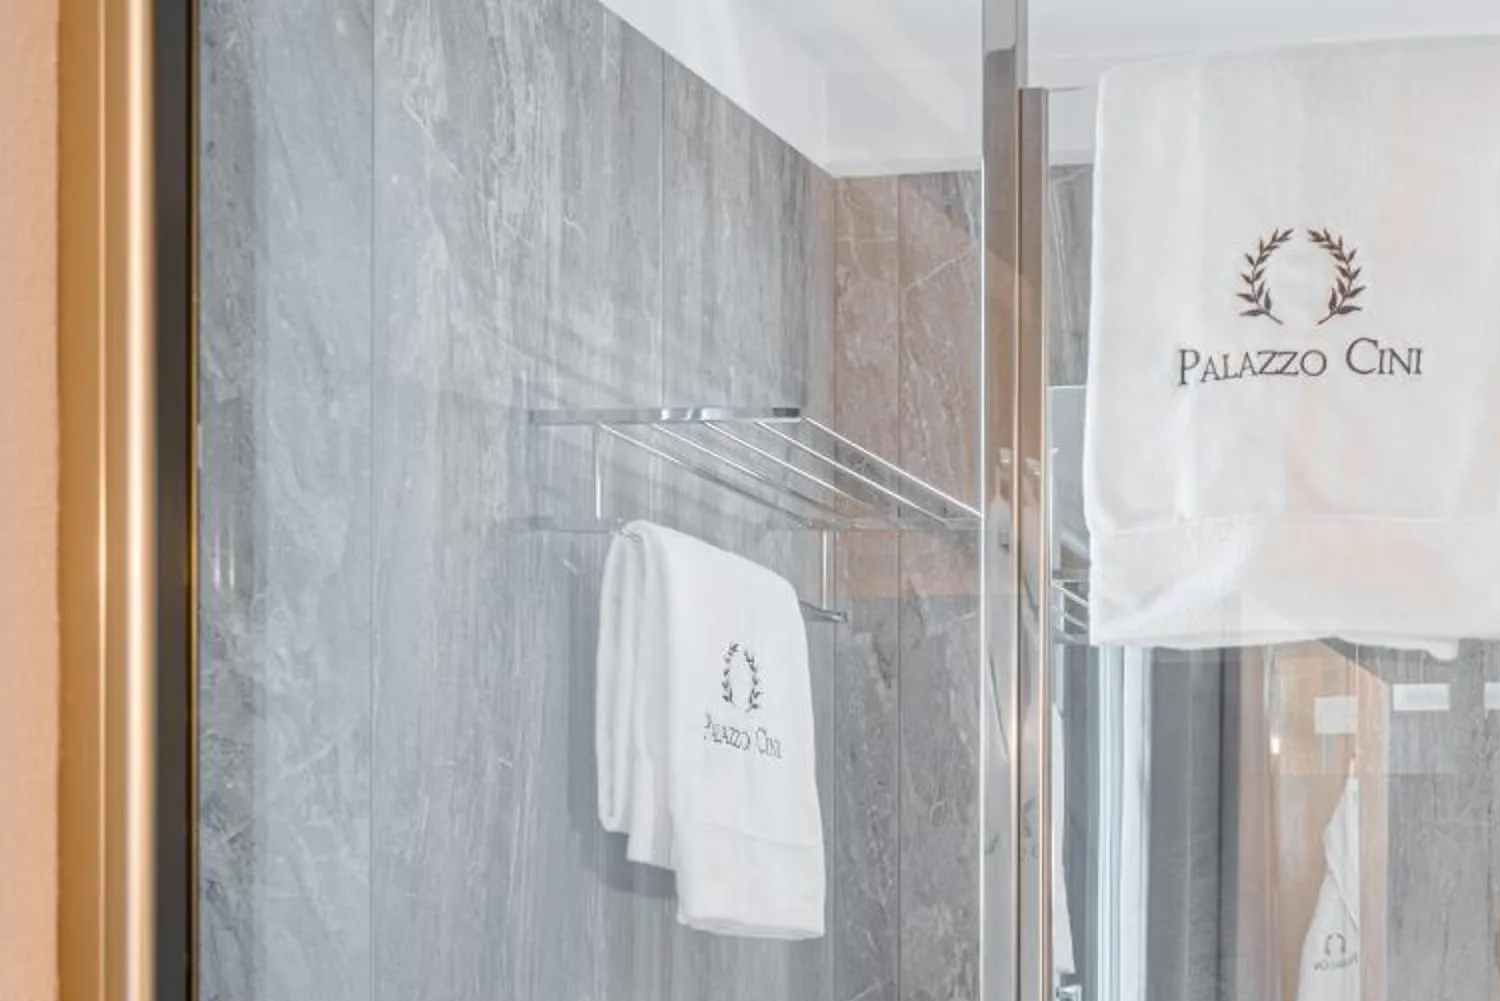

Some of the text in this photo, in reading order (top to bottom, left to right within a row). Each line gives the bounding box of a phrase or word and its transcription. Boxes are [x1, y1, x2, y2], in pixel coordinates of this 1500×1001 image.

[1178, 336, 1424, 387] PALAZZO CINI
[703, 711, 751, 751] PLAZZO
